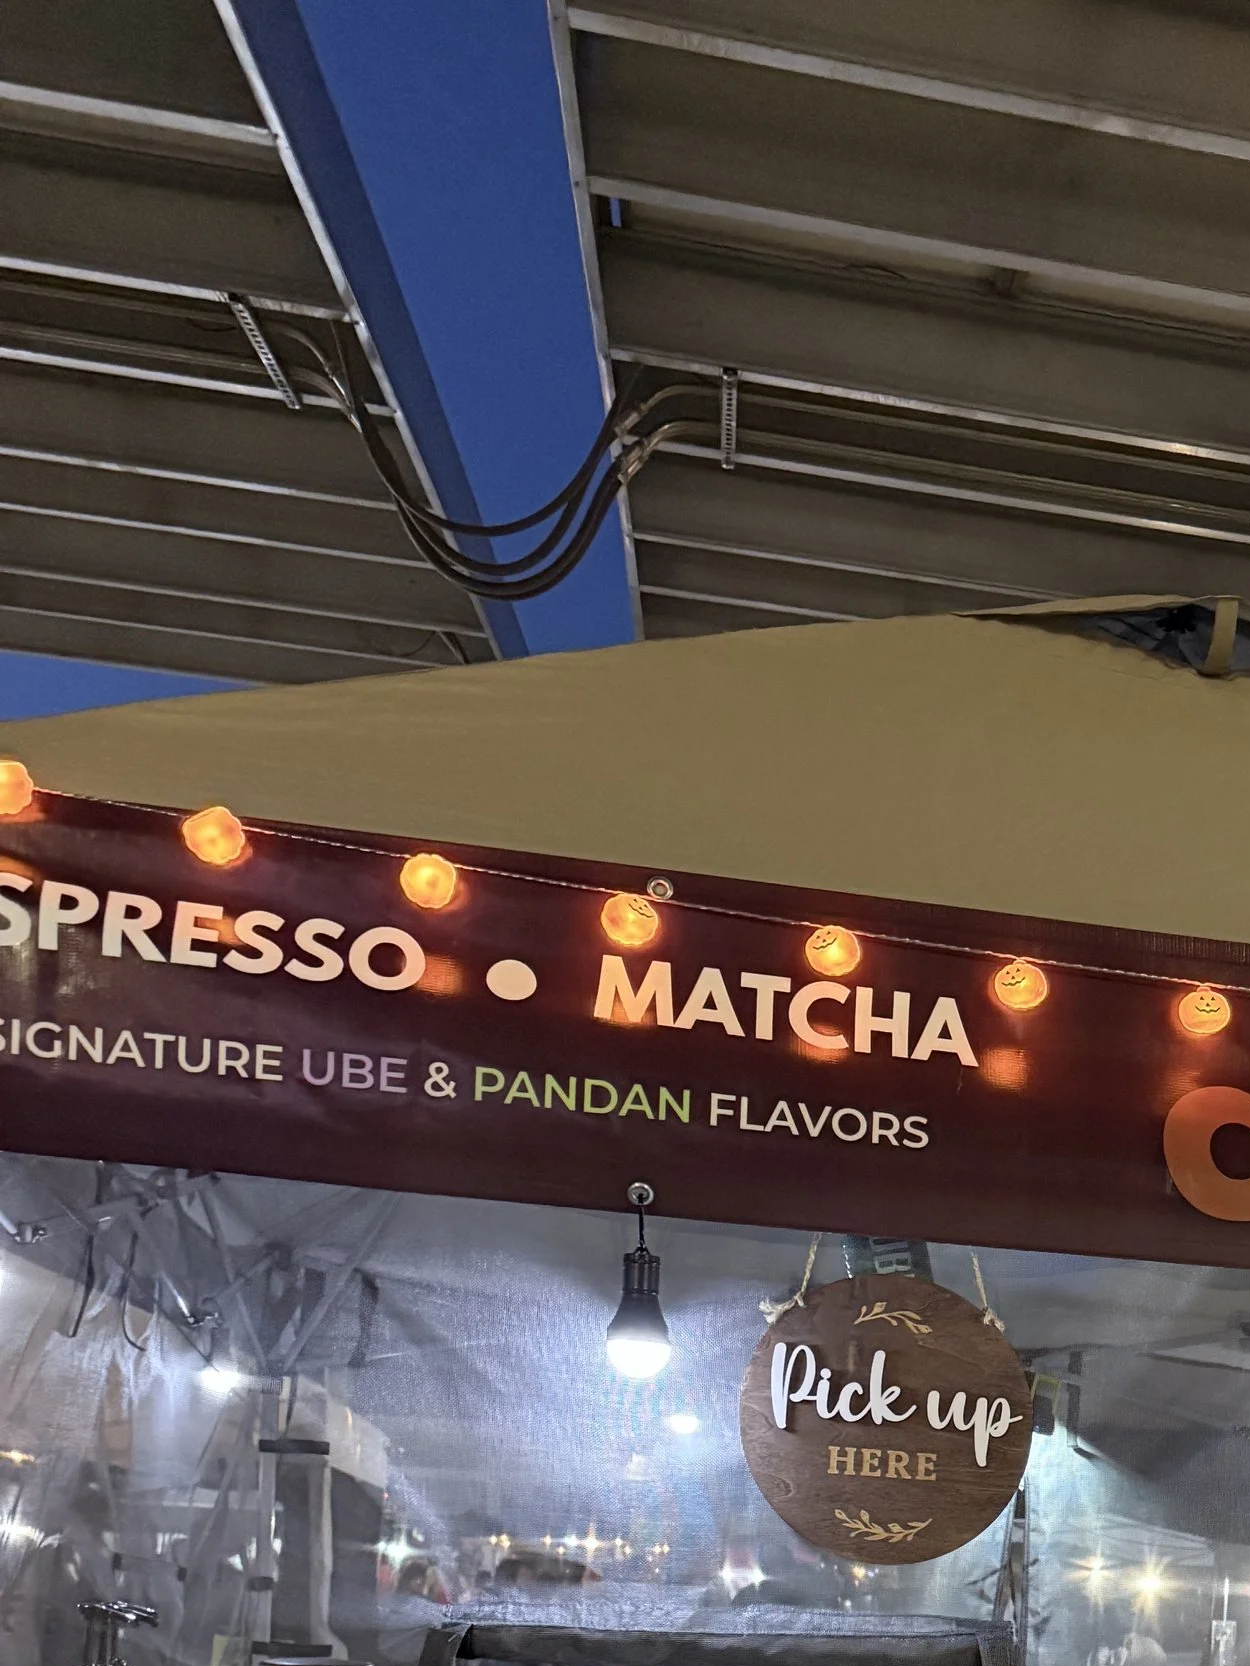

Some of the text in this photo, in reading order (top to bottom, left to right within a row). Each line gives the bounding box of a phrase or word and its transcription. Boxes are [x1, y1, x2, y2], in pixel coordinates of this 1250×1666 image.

[593, 954, 979, 1068] MATCHA
[0, 1017, 930, 1149] IGNATURE UBE & PANDAN FLAVORS
[770, 1341, 1024, 1468] Pick up
[826, 1445, 938, 1482] HERE
